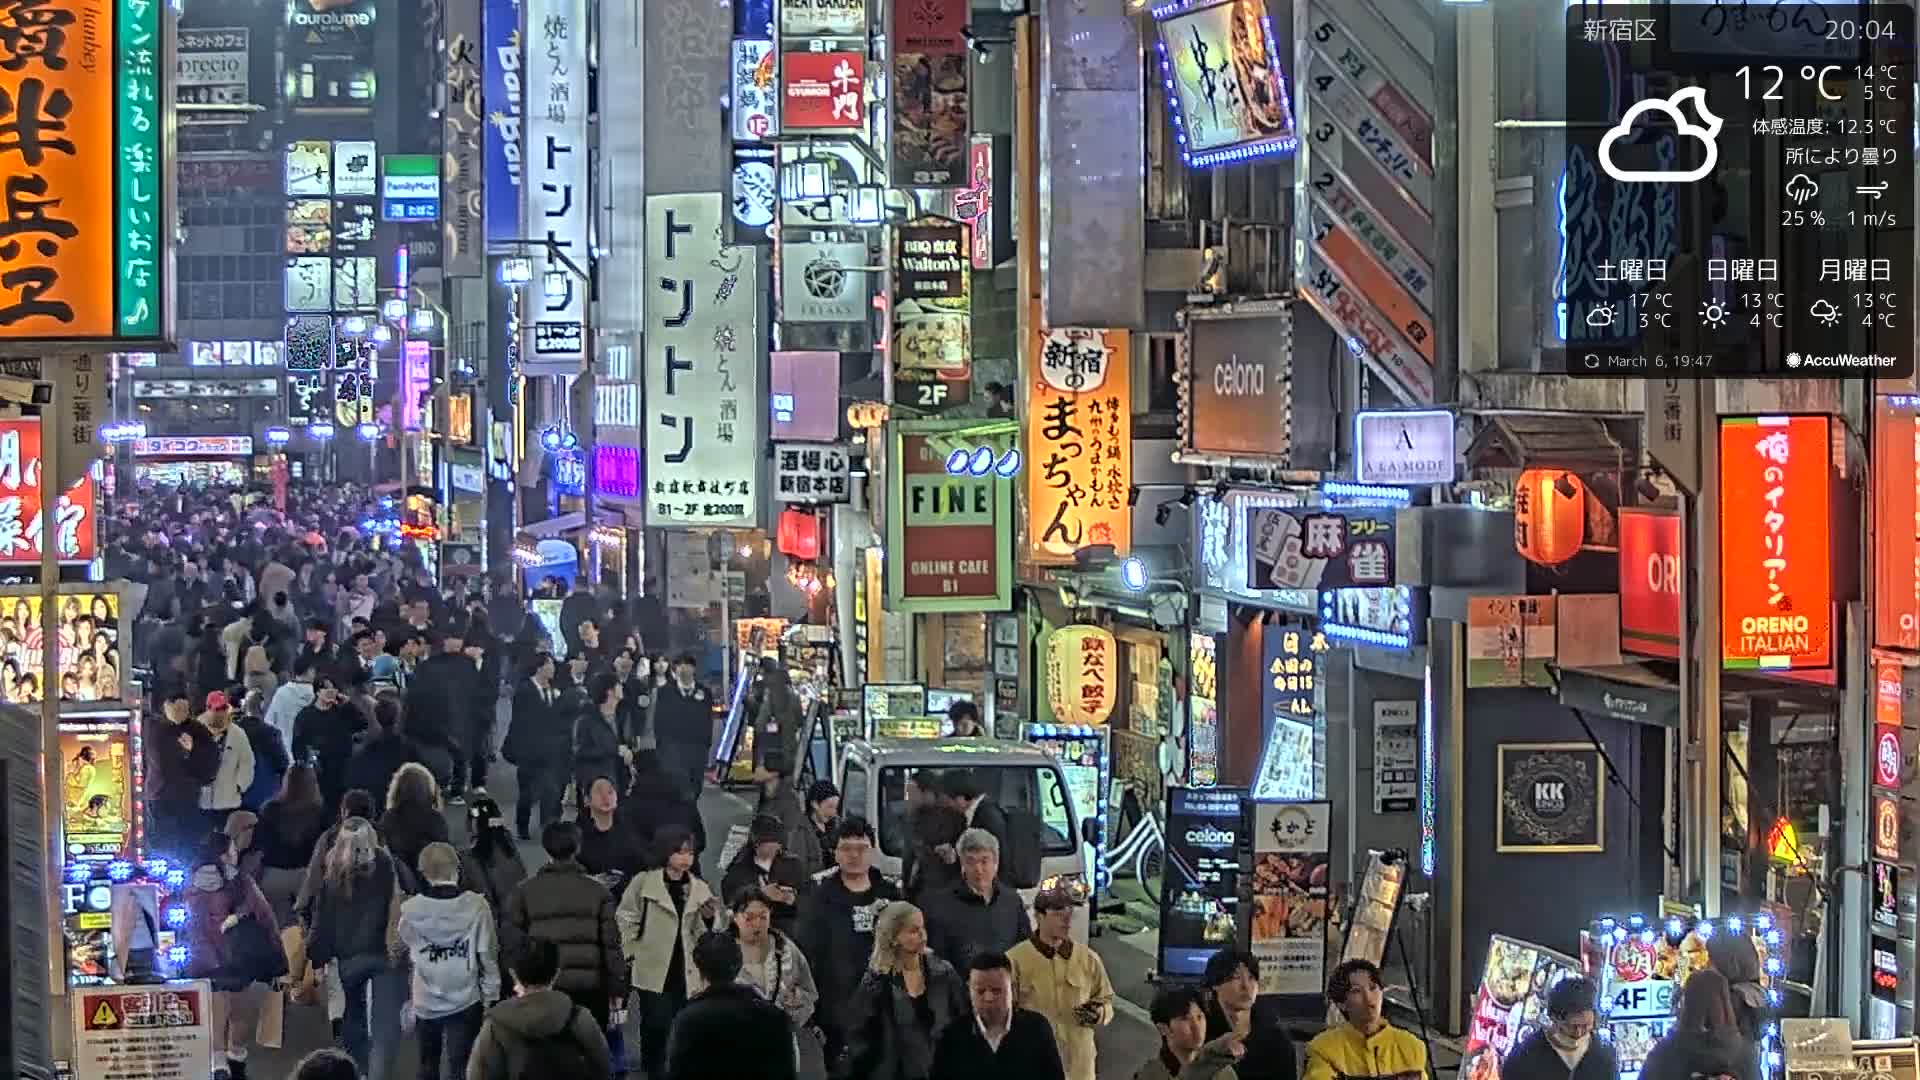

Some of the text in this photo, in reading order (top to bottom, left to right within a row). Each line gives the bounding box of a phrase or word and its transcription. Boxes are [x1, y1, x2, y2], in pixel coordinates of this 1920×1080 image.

[1315, 22, 1336, 42] 5
[1315, 75, 1335, 92] 4
[1316, 122, 1335, 142] 3
[1314, 172, 1335, 193] 2
[902, 256, 960, 273] Walton's
[658, 208, 694, 463] トントン
[1214, 353, 1265, 395] celona
[72, 354, 93, 445] 通り一番街
[918, 384, 948, 406] 2F
[780, 450, 845, 472] 酒場心
[1042, 396, 1084, 545] まっちゃん
[911, 486, 987, 514] FINE
[1755, 431, 1789, 605] 俺のイタリアン
[1350, 521, 1391, 536] フリー
[911, 559, 989, 575] ONLINE CAFE
[943, 579, 959, 593] B1
[1741, 615, 1809, 634] ORENO
[1741, 635, 1809, 653] ITALIAN
[1535, 782, 1564, 801] KK
[1185, 832, 1235, 845] celona
[1614, 987, 1648, 1010] 4F
